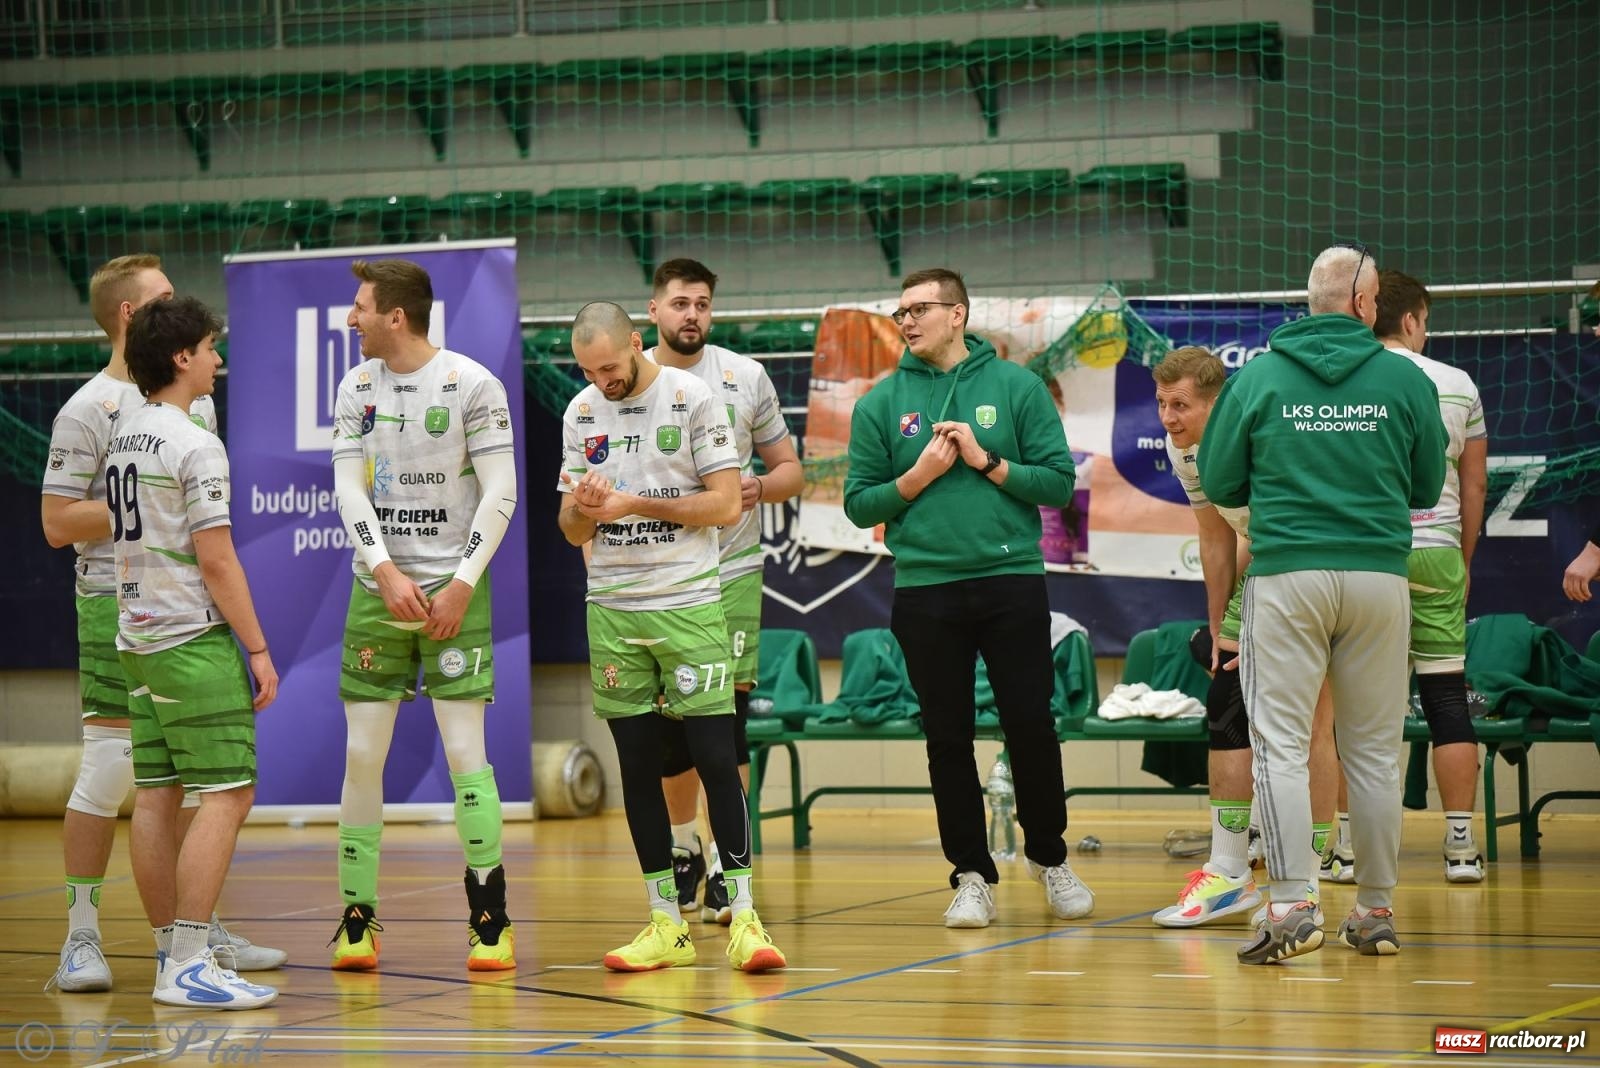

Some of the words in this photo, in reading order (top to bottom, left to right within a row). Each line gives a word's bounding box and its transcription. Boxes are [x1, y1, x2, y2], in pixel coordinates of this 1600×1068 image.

[1282, 405, 1314, 418] LKS
[1318, 405, 1388, 419] OLIMPIA
[1294, 421, 1377, 431] WŁODOWICE
[623, 435, 641, 453] 77
[399, 472, 446, 485] GUARD
[106, 462, 142, 543] 99
[398, 509, 448, 523] CIEPŁA
[391, 526, 411, 536] 944
[415, 526, 439, 536] 146
[652, 533, 676, 544] 146
[472, 647, 482, 675] 7
[699, 663, 726, 692] 77
